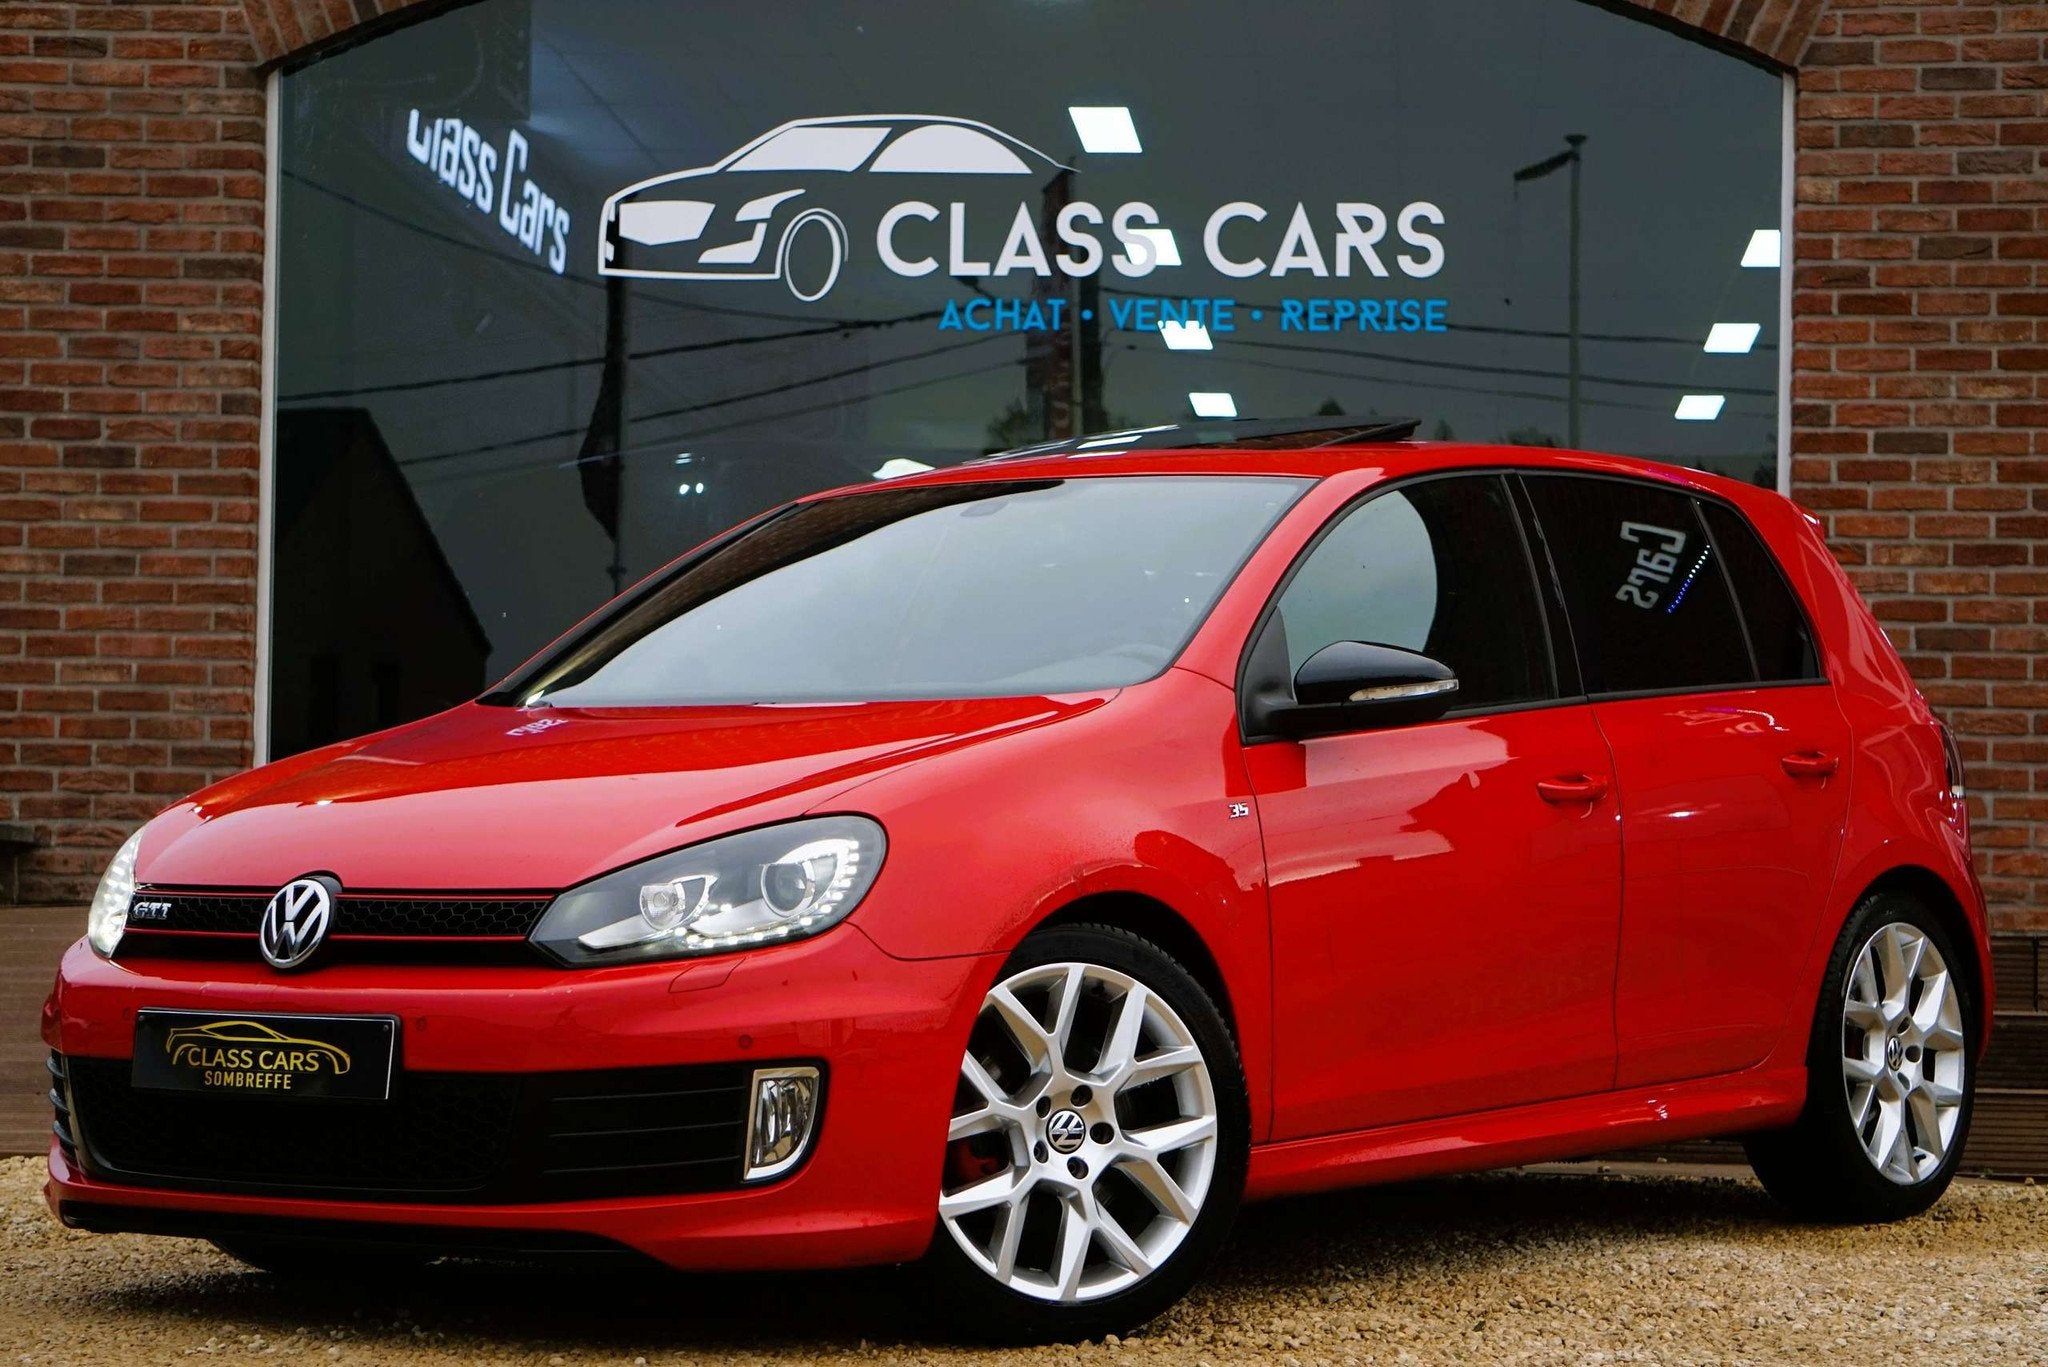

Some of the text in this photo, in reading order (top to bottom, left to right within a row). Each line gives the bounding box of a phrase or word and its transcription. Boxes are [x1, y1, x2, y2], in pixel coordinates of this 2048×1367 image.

[500, 128, 571, 275] Cars
[876, 200, 1447, 278] CLASS CARS
[938, 298, 1448, 332] ACHAT VENTE REPRISE
[1229, 803, 1249, 818] 35
[132, 901, 172, 919] GTI
[187, 1047, 320, 1072] CLASS CARS
[204, 1070, 292, 1089] SOMBREFFE
